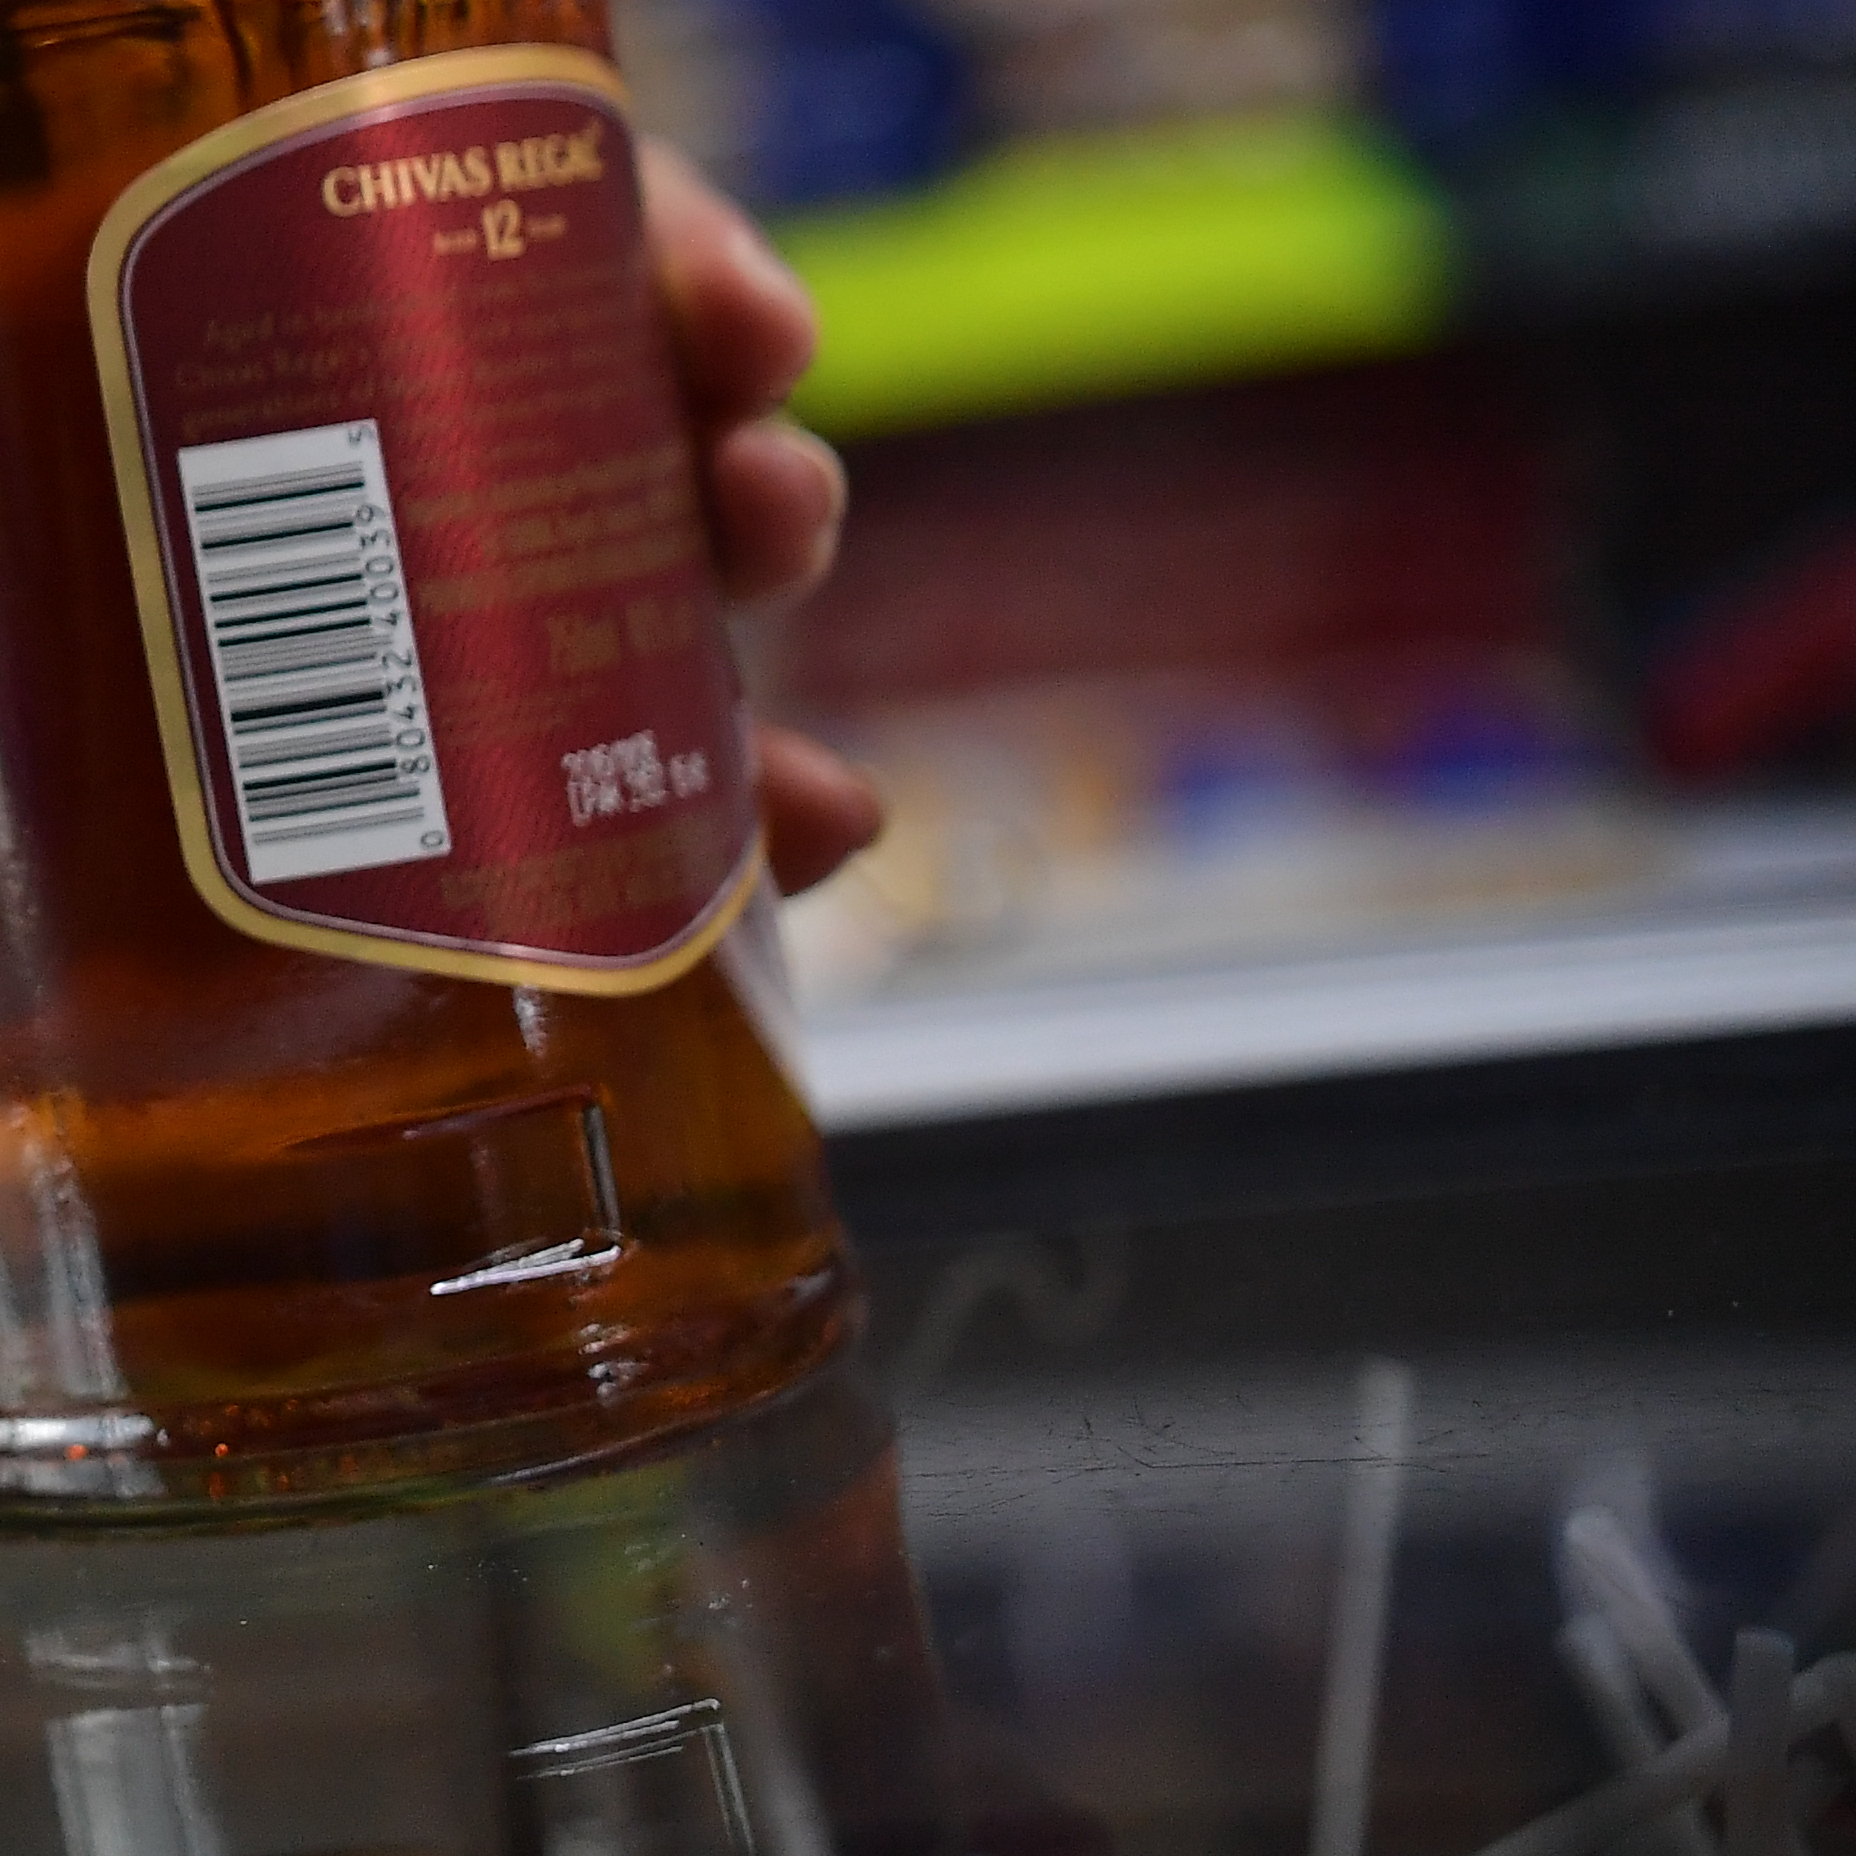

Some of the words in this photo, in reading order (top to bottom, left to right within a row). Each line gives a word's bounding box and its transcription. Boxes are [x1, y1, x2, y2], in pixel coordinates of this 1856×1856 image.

[321, 145, 493, 217] CHIVAS
[481, 198, 526, 261] 12
[354, 505, 401, 630] 40039
[382, 647, 431, 776] 80432
[419, 829, 444, 848] 0
